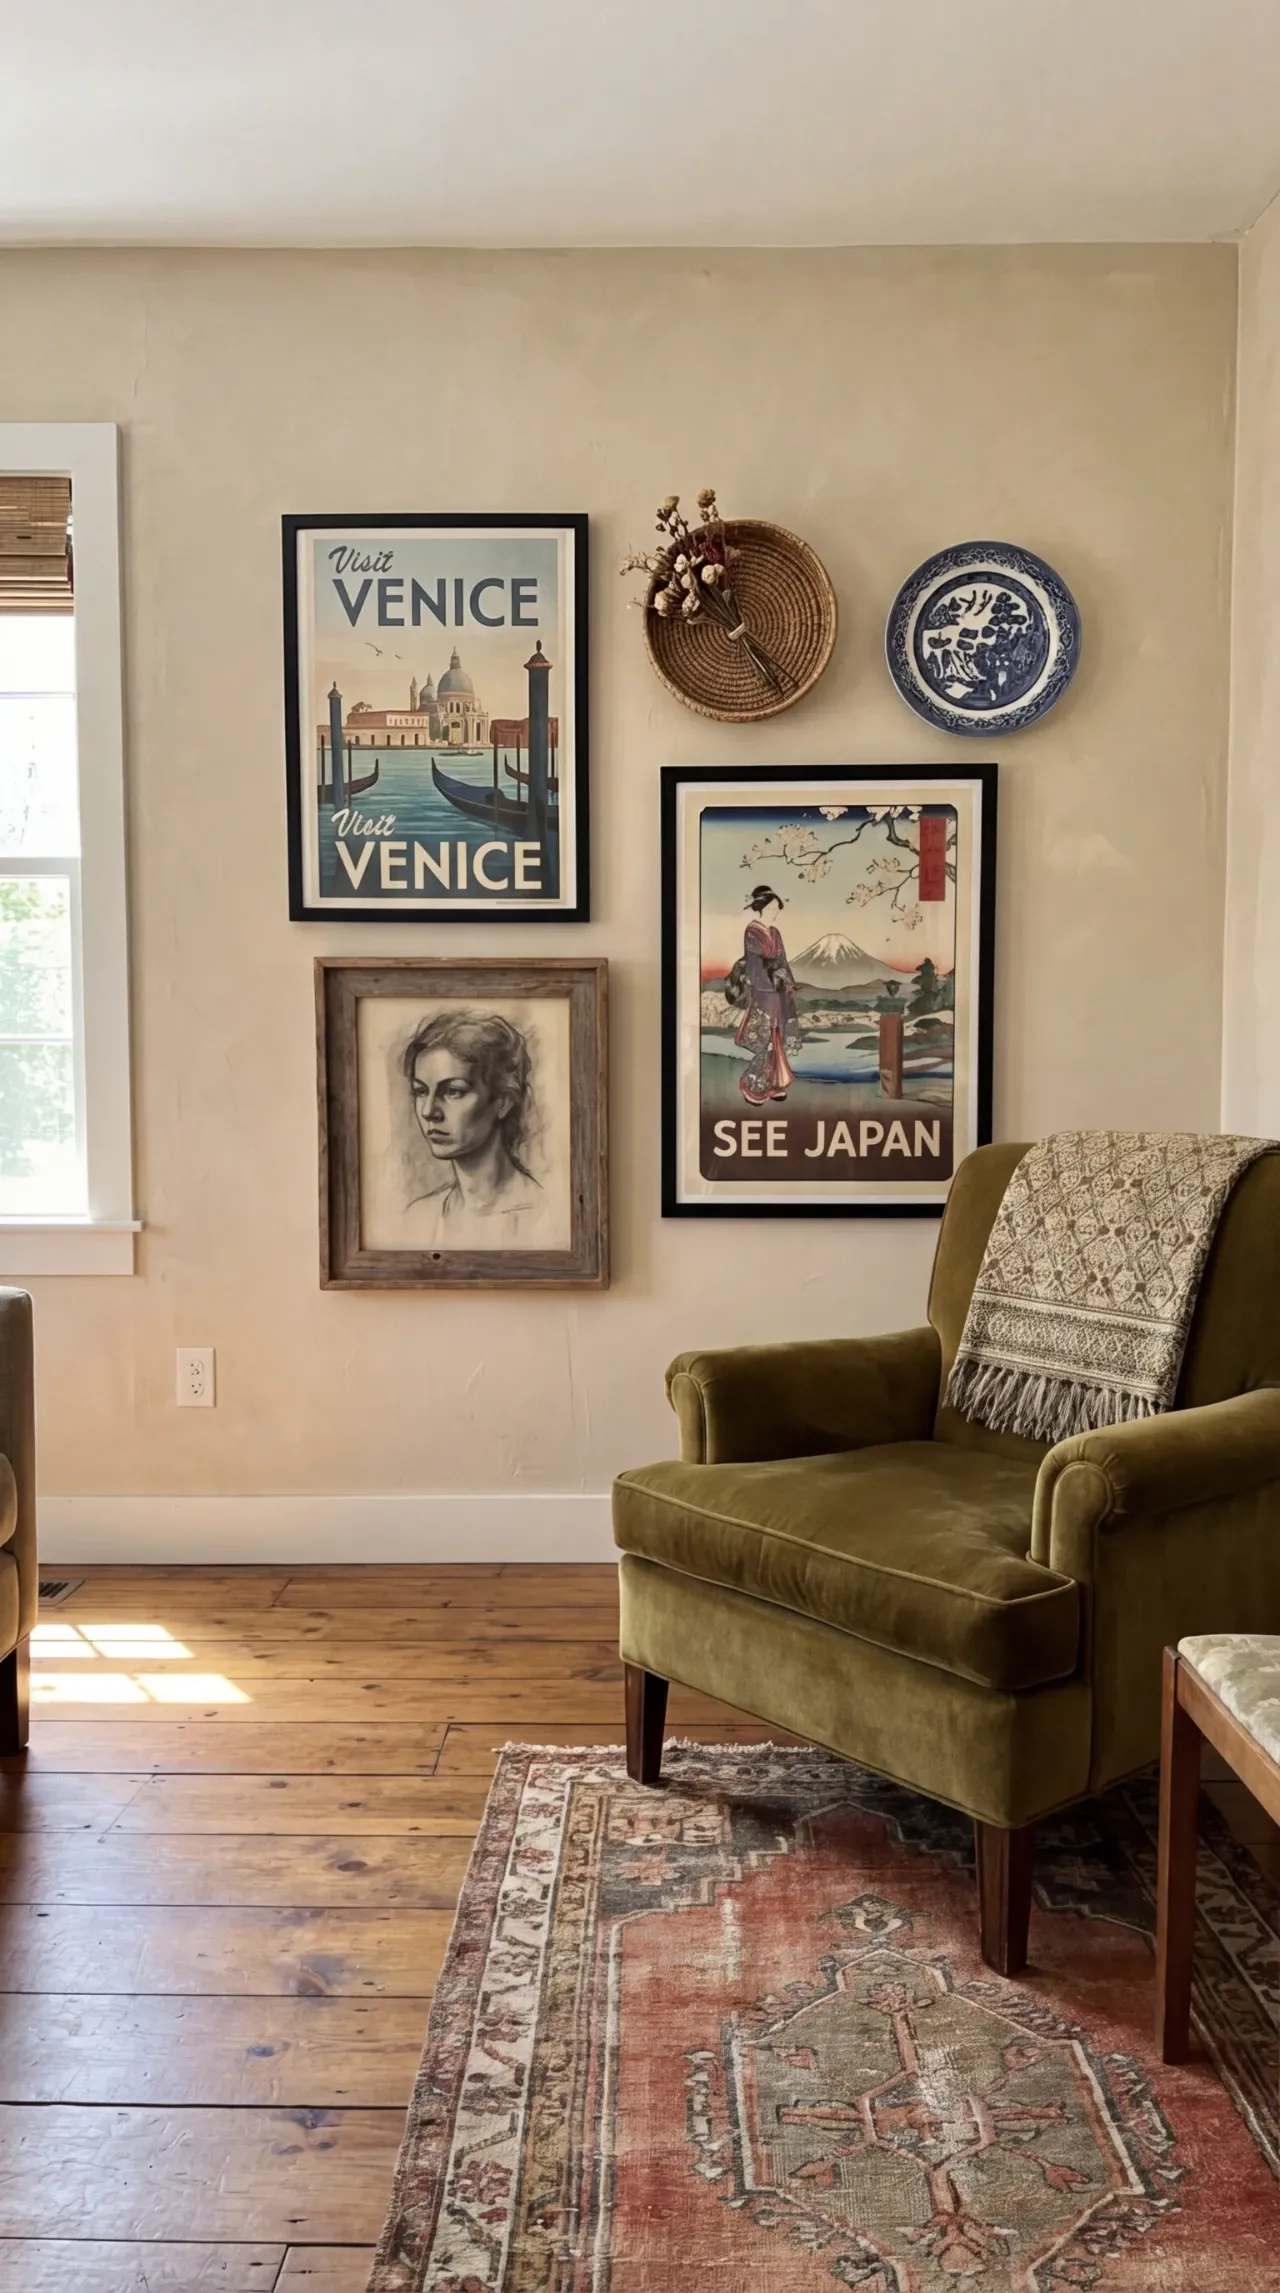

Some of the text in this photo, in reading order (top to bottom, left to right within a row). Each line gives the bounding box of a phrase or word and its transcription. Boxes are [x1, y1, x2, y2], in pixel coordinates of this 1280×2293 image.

[328, 545, 394, 574] Visit
[332, 577, 538, 627] VENICE
[334, 841, 542, 890] VENICE
[713, 1120, 941, 1157] SEE JAPAN
